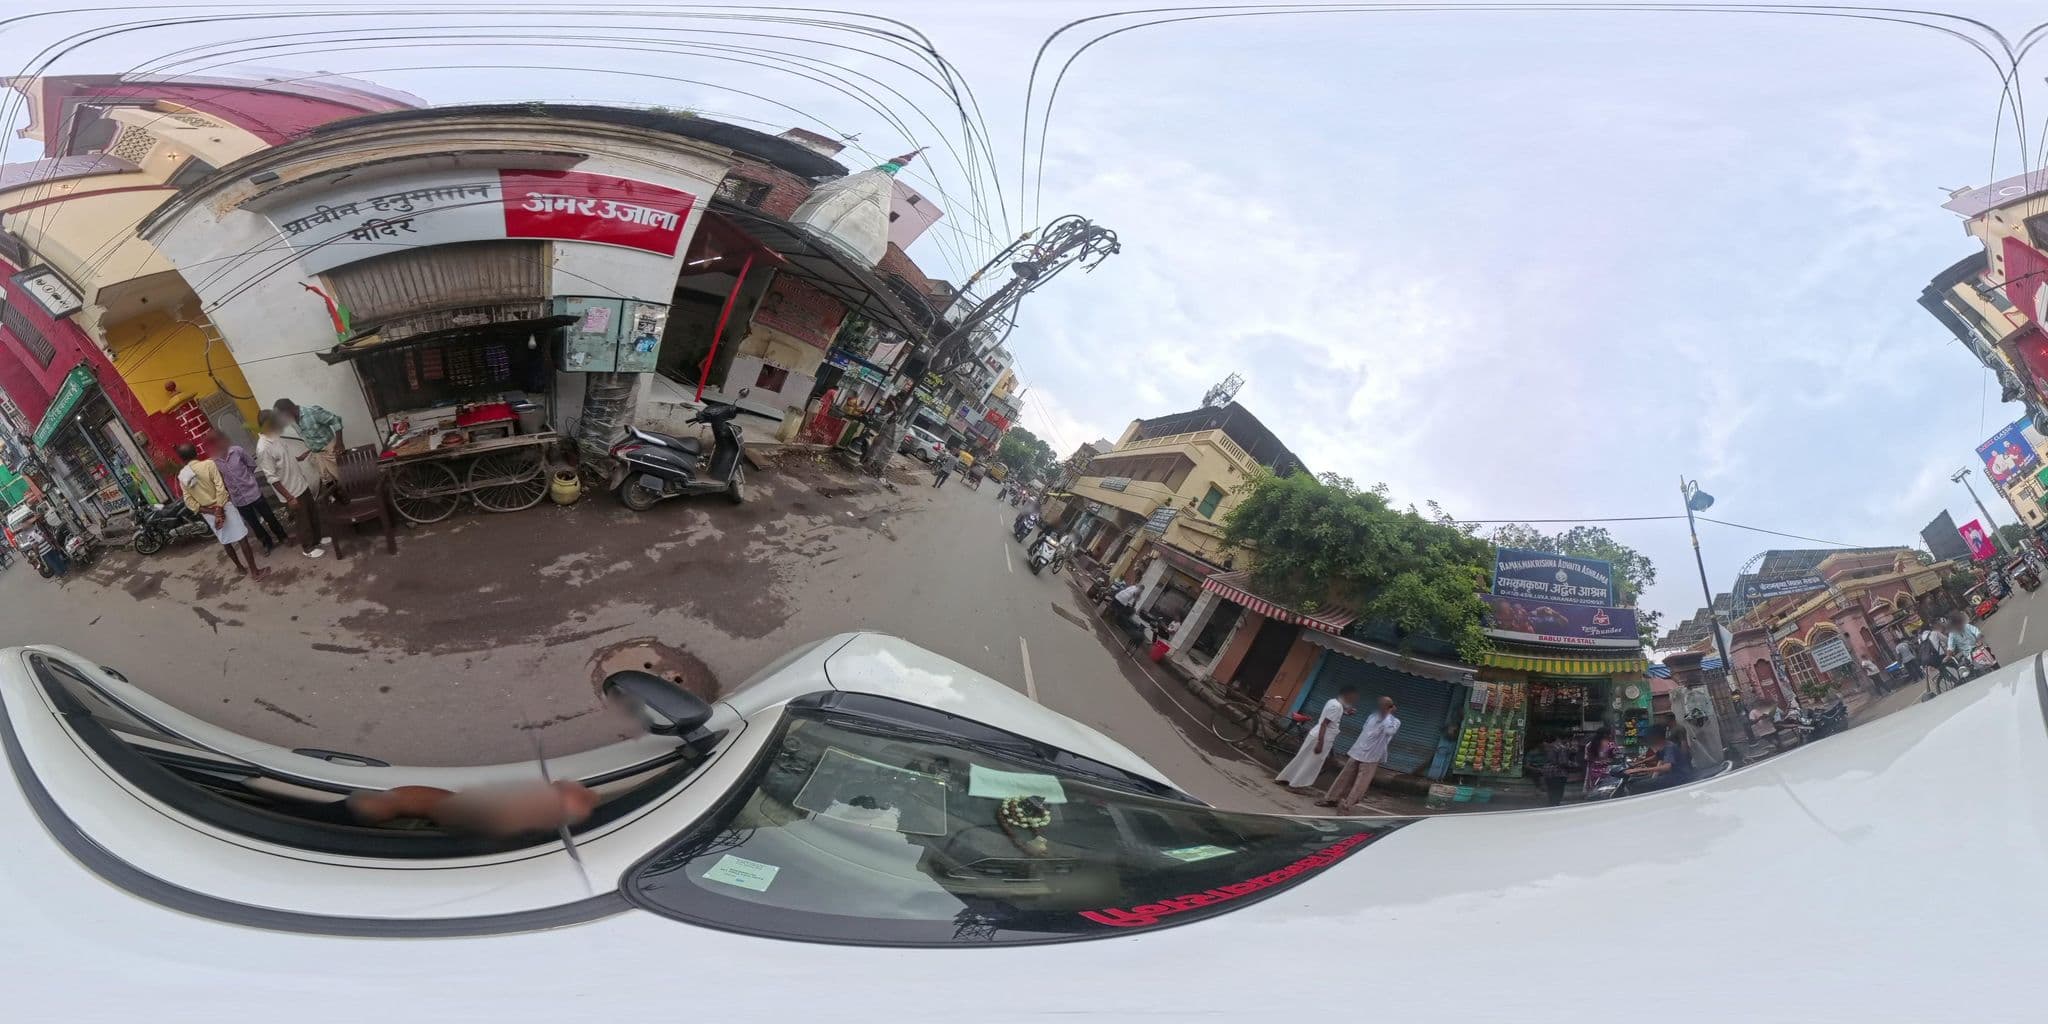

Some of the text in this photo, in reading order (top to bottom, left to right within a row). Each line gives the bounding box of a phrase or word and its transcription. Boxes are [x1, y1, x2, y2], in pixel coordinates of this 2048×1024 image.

[283, 203, 359, 236] प्राचीन
[522, 192, 680, 231] अमर उजाला
[350, 218, 417, 241] मंदिर
[1551, 582, 1577, 596] अद्वैत
[1578, 587, 1606, 598] आश्रम
